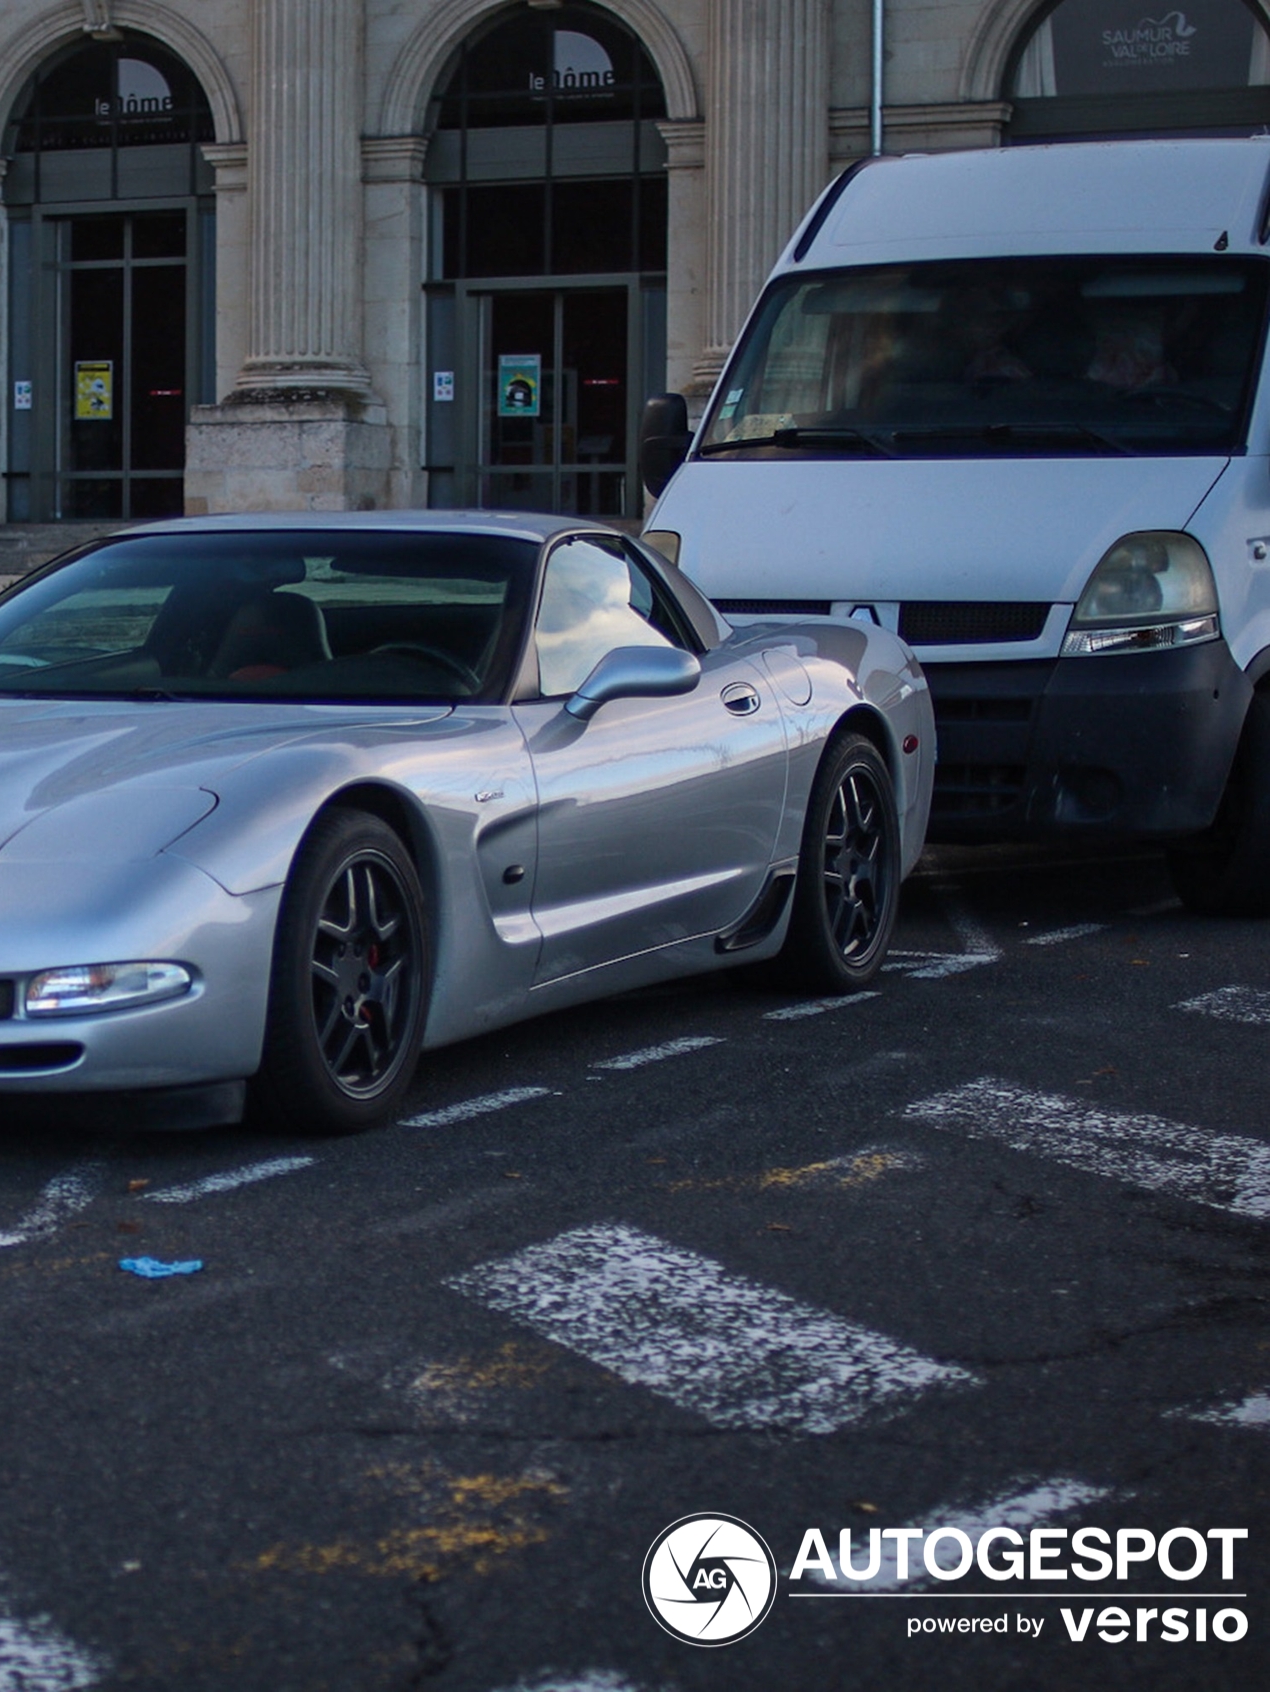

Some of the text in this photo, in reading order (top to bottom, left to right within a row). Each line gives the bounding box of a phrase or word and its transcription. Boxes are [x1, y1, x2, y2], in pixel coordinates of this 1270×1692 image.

[1102, 27, 1172, 45] SAUMUR
[1110, 45, 1137, 58] VAL
[1149, 41, 1190, 57] LOIRE
[529, 71, 545, 90] le
[95, 97, 110, 115] le
